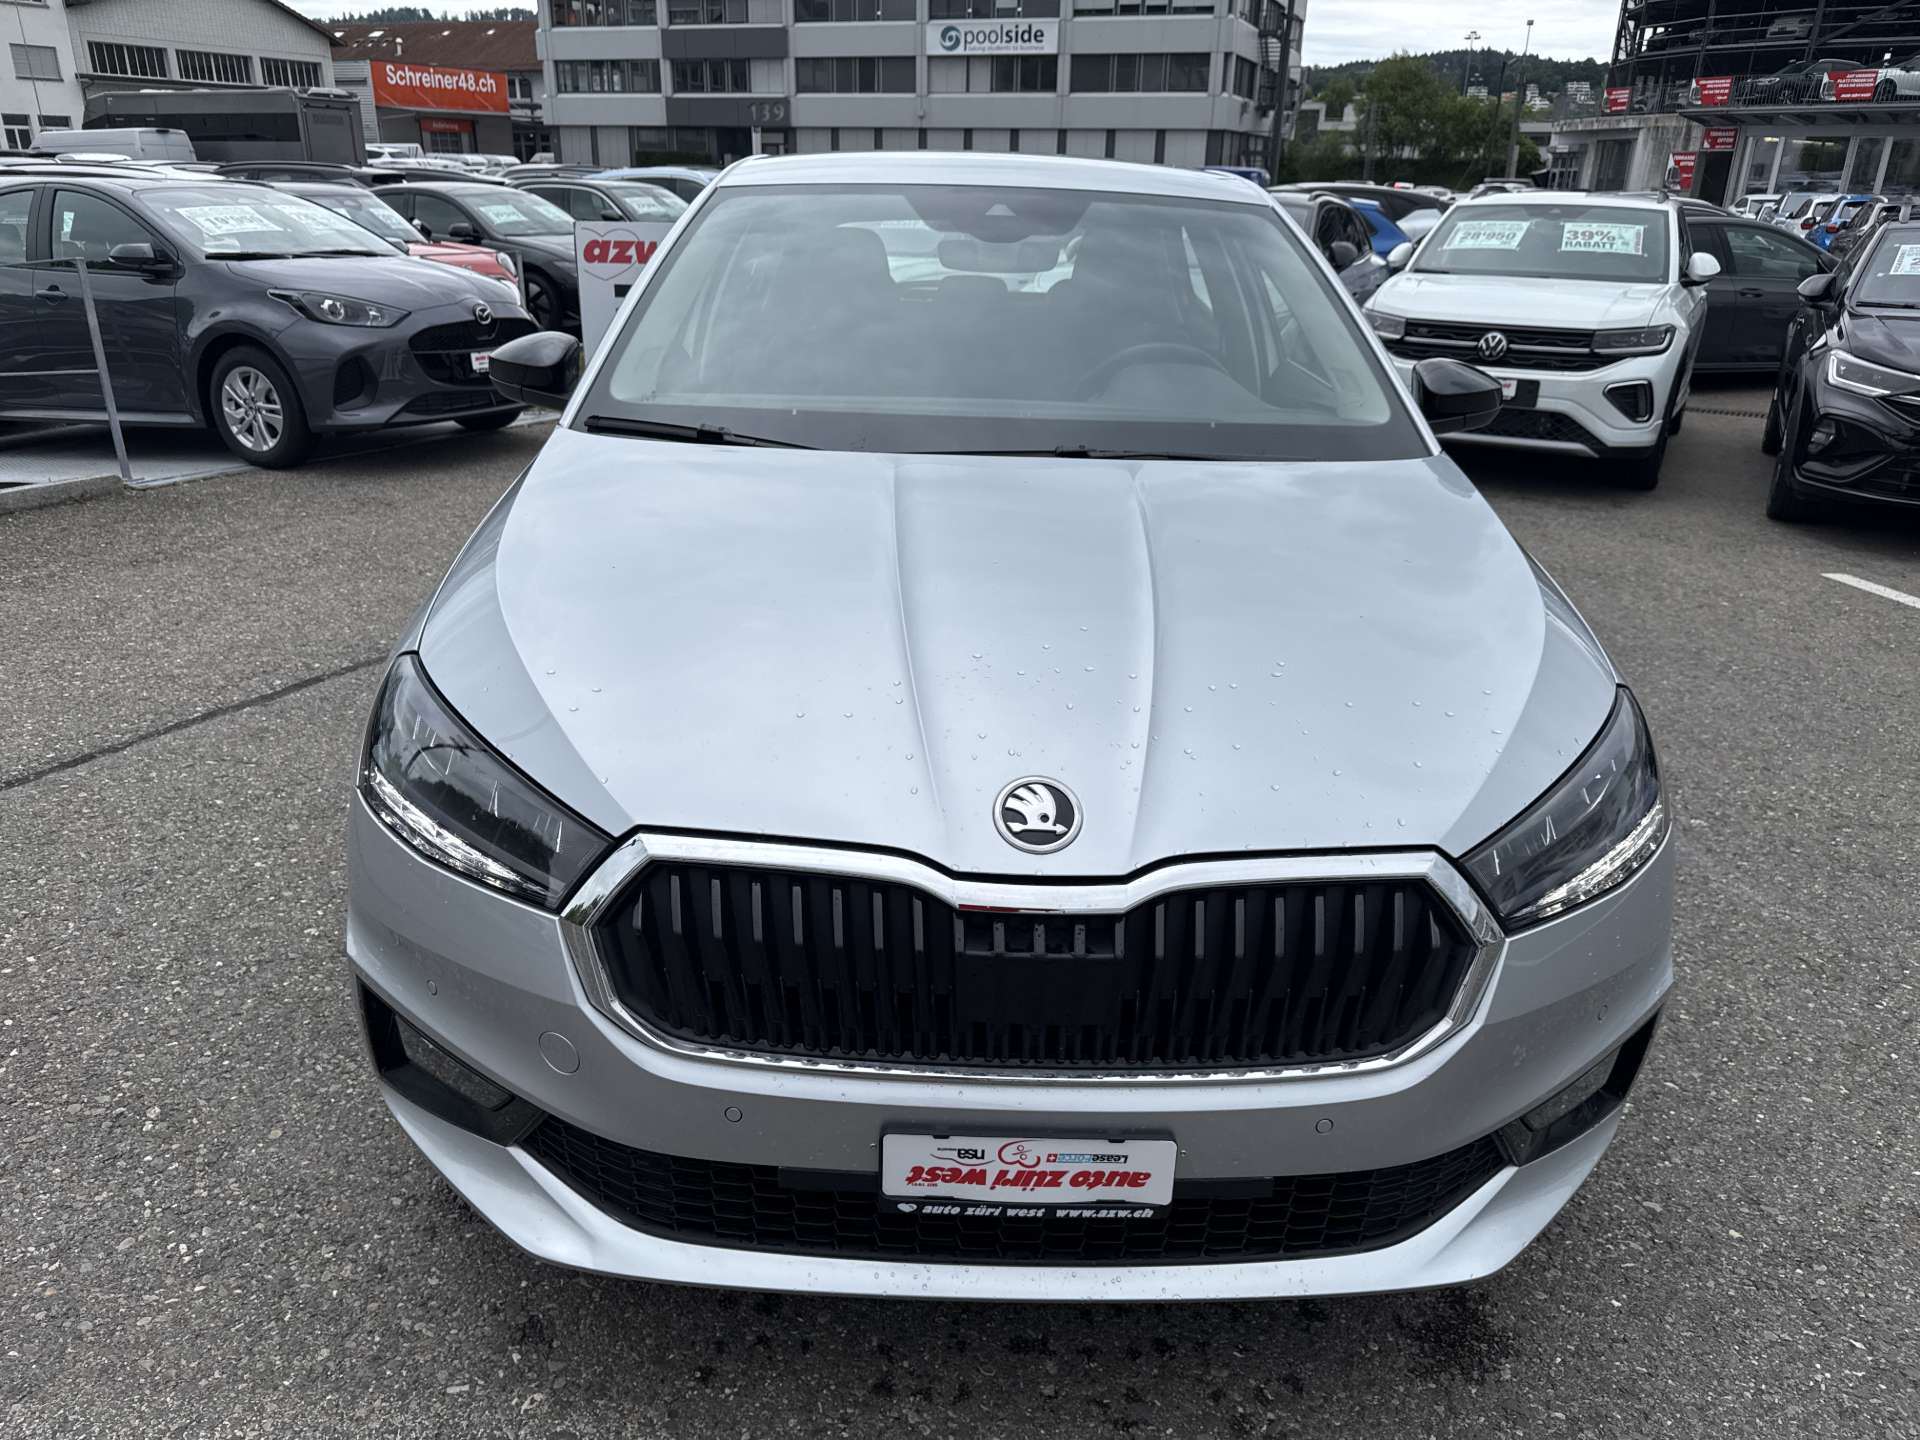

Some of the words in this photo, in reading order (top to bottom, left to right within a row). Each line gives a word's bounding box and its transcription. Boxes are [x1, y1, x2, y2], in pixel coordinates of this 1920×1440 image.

[964, 24, 1044, 51] poolside
[386, 64, 496, 93] Schreiner48.ch
[751, 104, 785, 121] 139
[1565, 241, 1616, 249] RABATT
[1566, 230, 1616, 242] 39%
[956, 1148, 985, 1160] nsa
[905, 1165, 987, 1186] west
[990, 1168, 1069, 1192] züri
[1070, 1170, 1151, 1190] auto
[922, 1204, 961, 1215] auto
[964, 1205, 1002, 1216] züri
[1006, 1207, 1046, 1217] west
[1056, 1208, 1154, 1219] www.azw.ch
